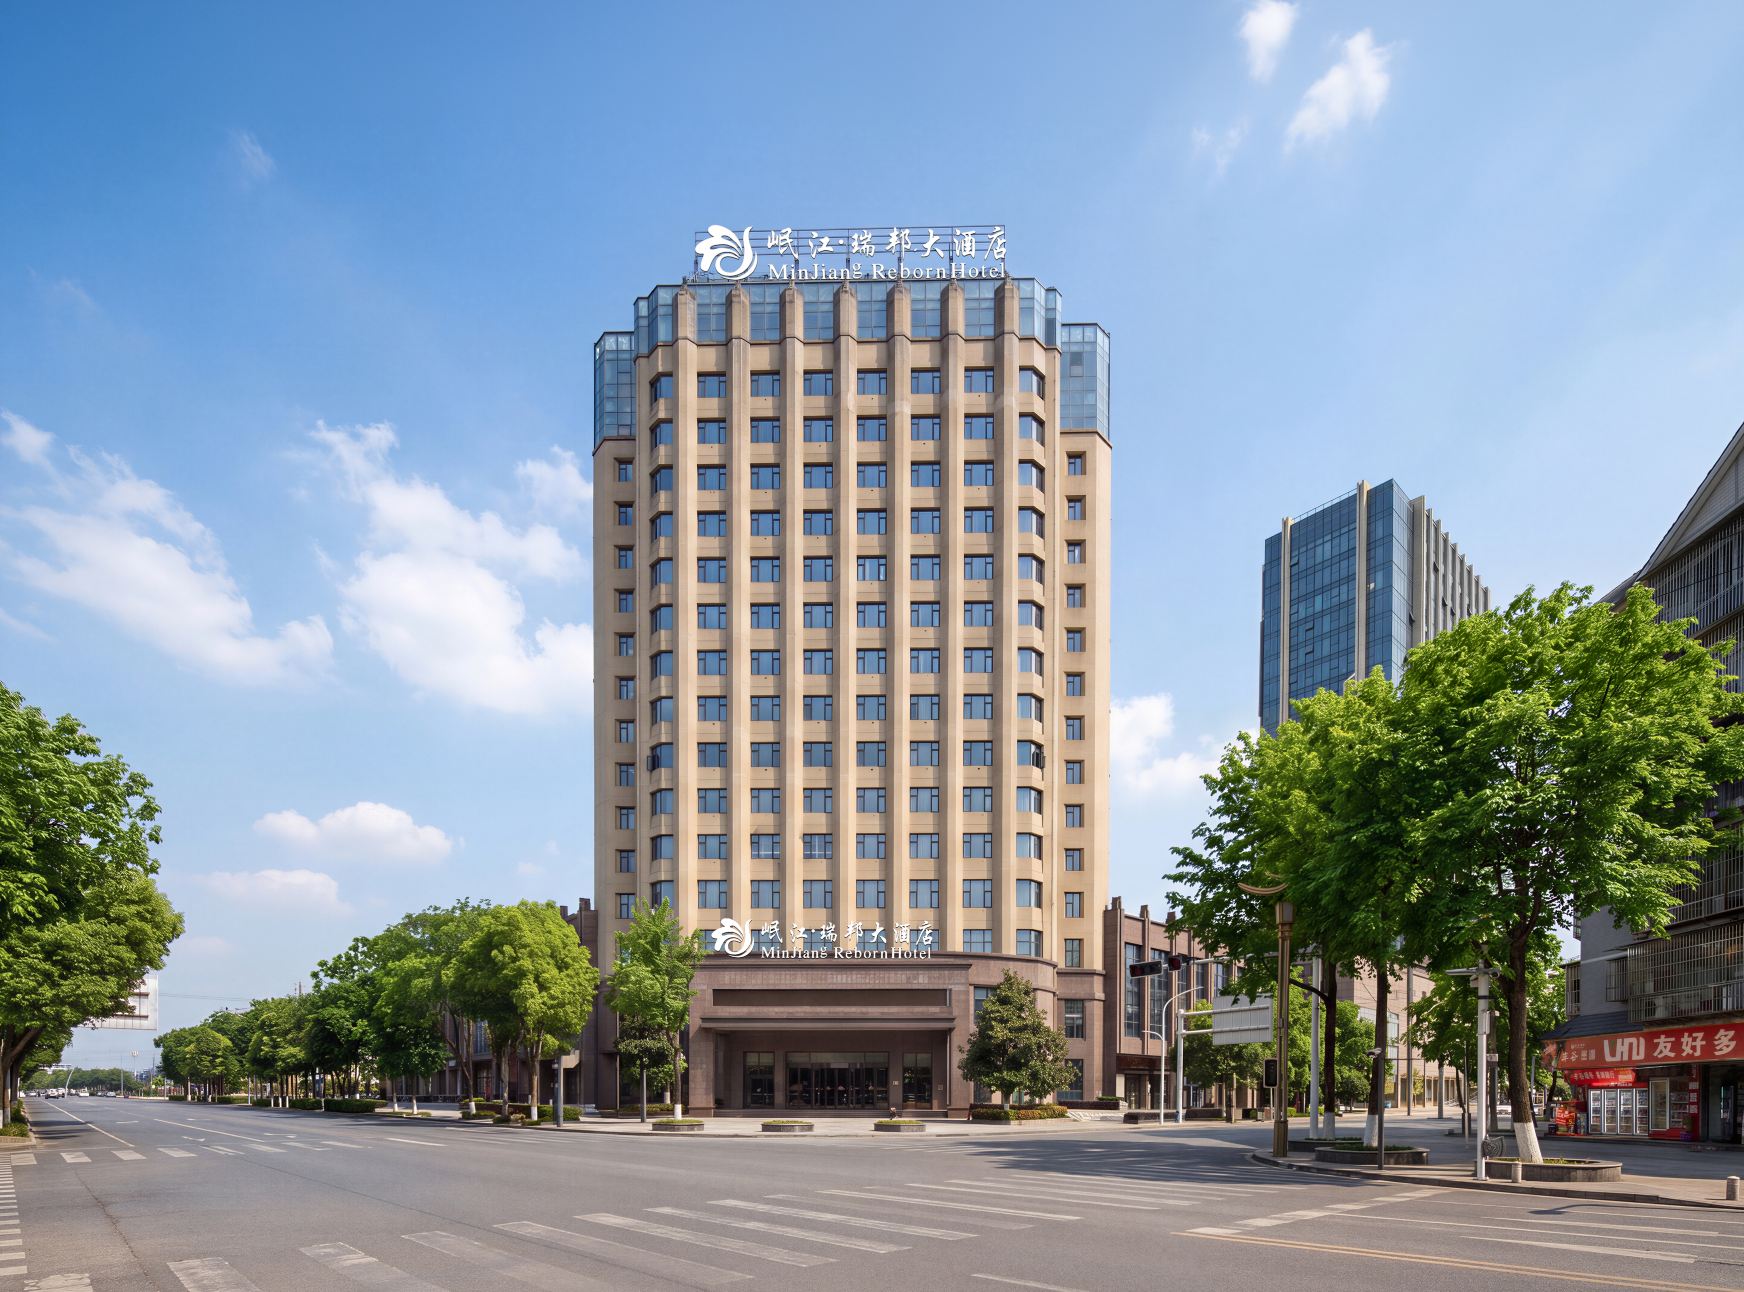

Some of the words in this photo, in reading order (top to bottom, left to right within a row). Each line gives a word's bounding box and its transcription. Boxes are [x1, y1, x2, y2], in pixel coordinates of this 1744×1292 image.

[768, 263, 862, 280] MinJiang
[761, 946, 828, 959] MinJiang
[1653, 1028, 1737, 1058] 友好多
